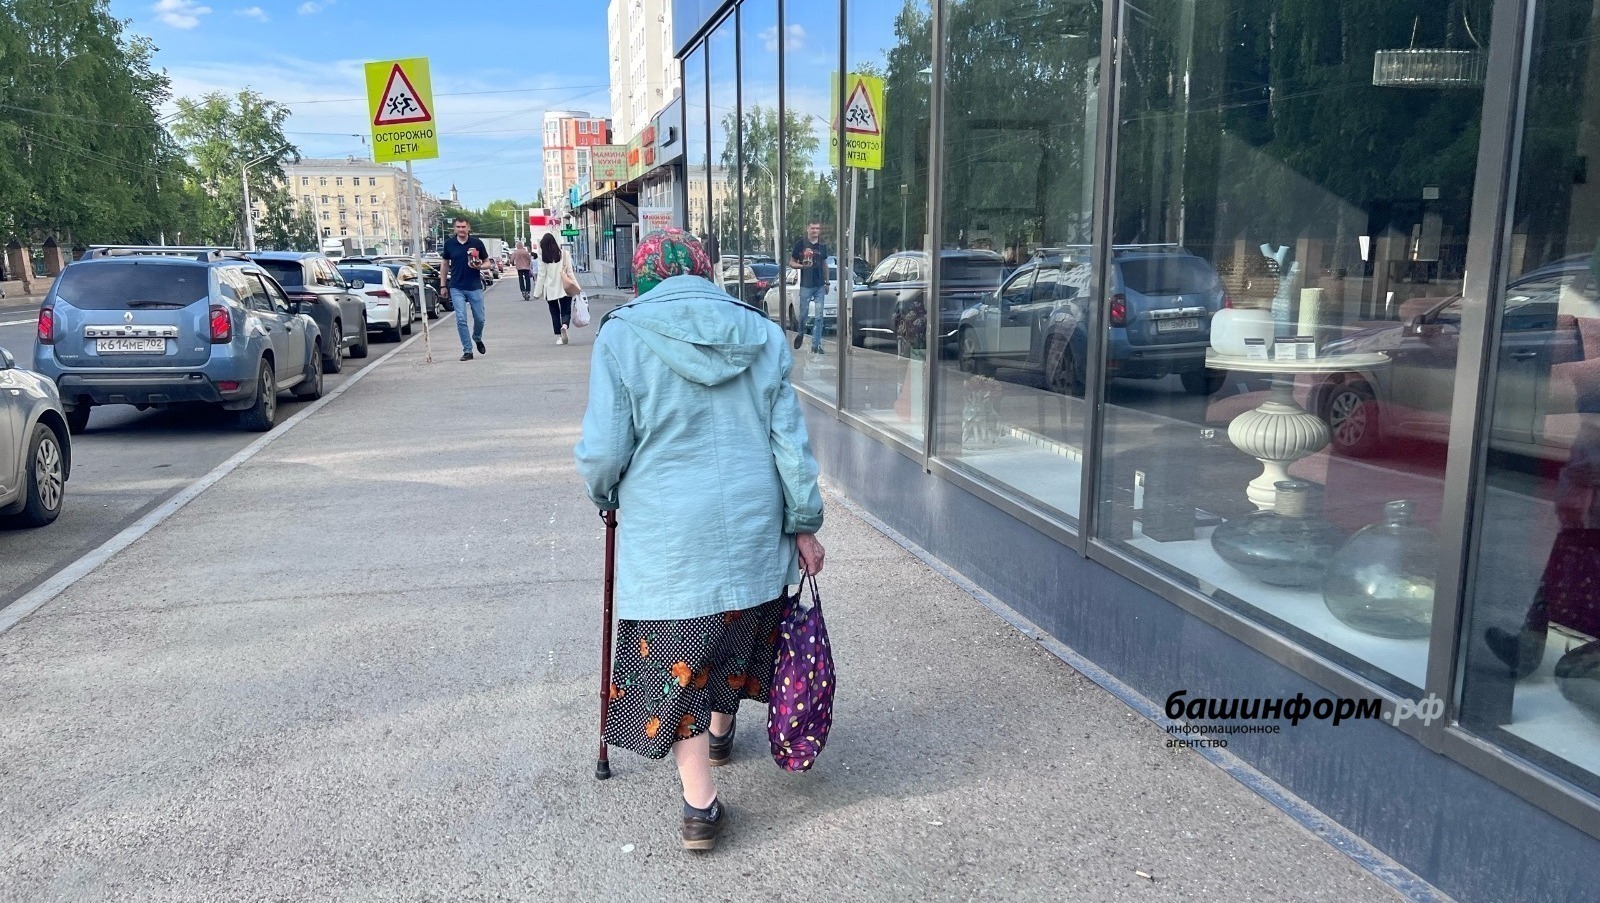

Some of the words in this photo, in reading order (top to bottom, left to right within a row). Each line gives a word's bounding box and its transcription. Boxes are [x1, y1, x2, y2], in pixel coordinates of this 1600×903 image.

[375, 129, 433, 142] ОСТОРОЖНО
[393, 143, 418, 155] ДЕТИ
[145, 338, 162, 348] 702
